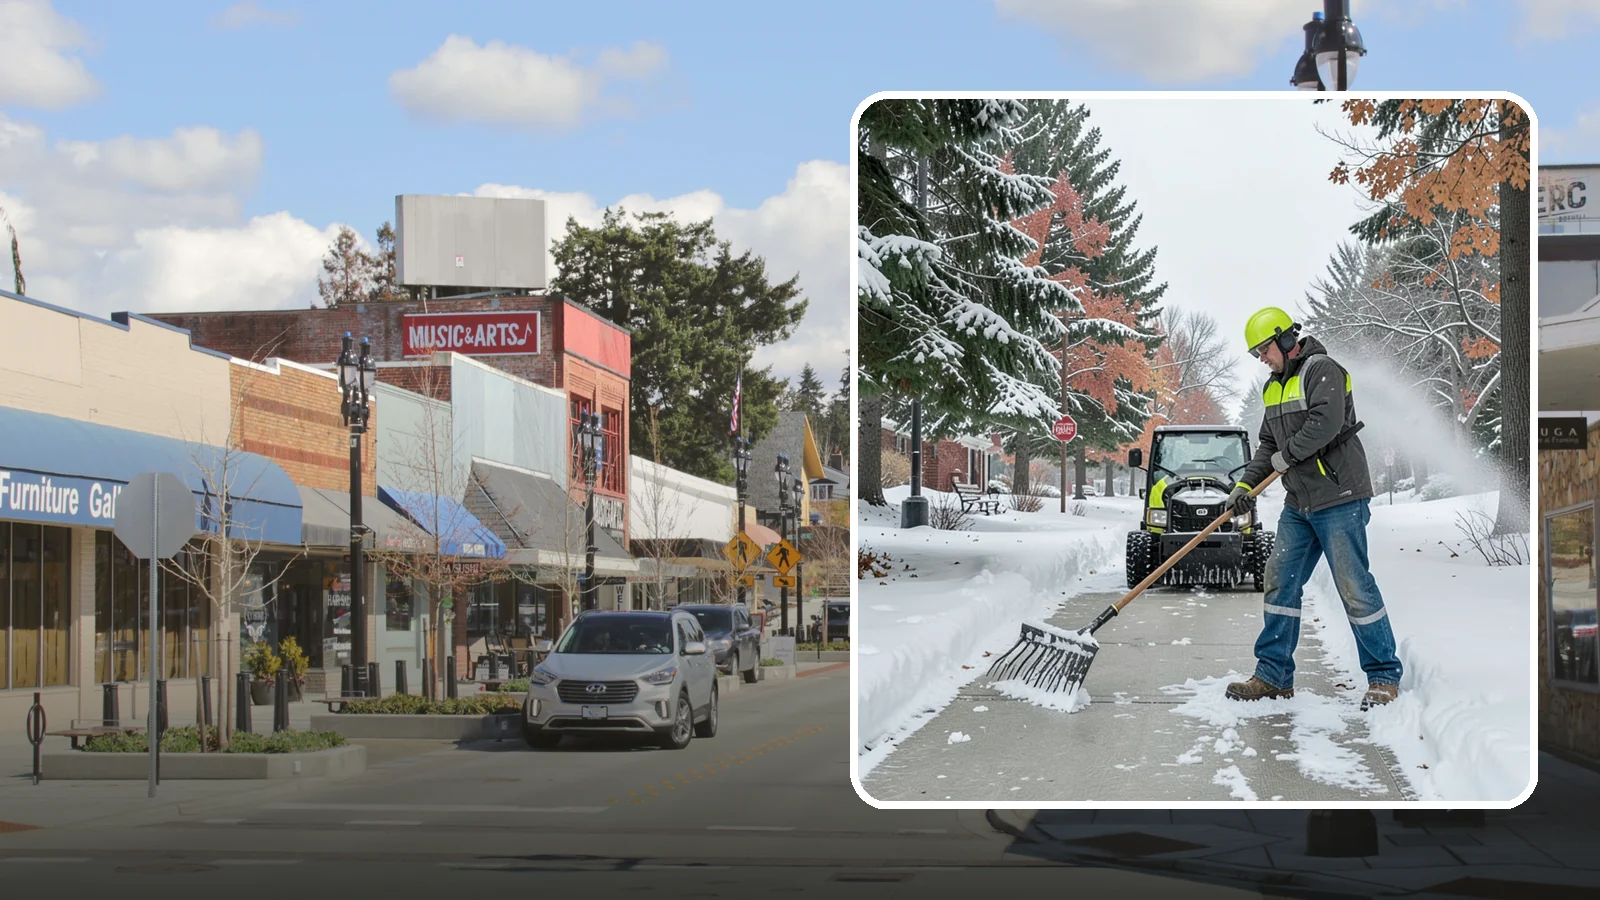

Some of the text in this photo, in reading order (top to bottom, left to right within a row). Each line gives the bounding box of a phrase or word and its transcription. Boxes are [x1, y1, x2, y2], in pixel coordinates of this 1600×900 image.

[1540, 427, 1577, 436] UGA
[0, 471, 122, 519] Furniture Gal
[453, 563, 480, 574] SUSHI
